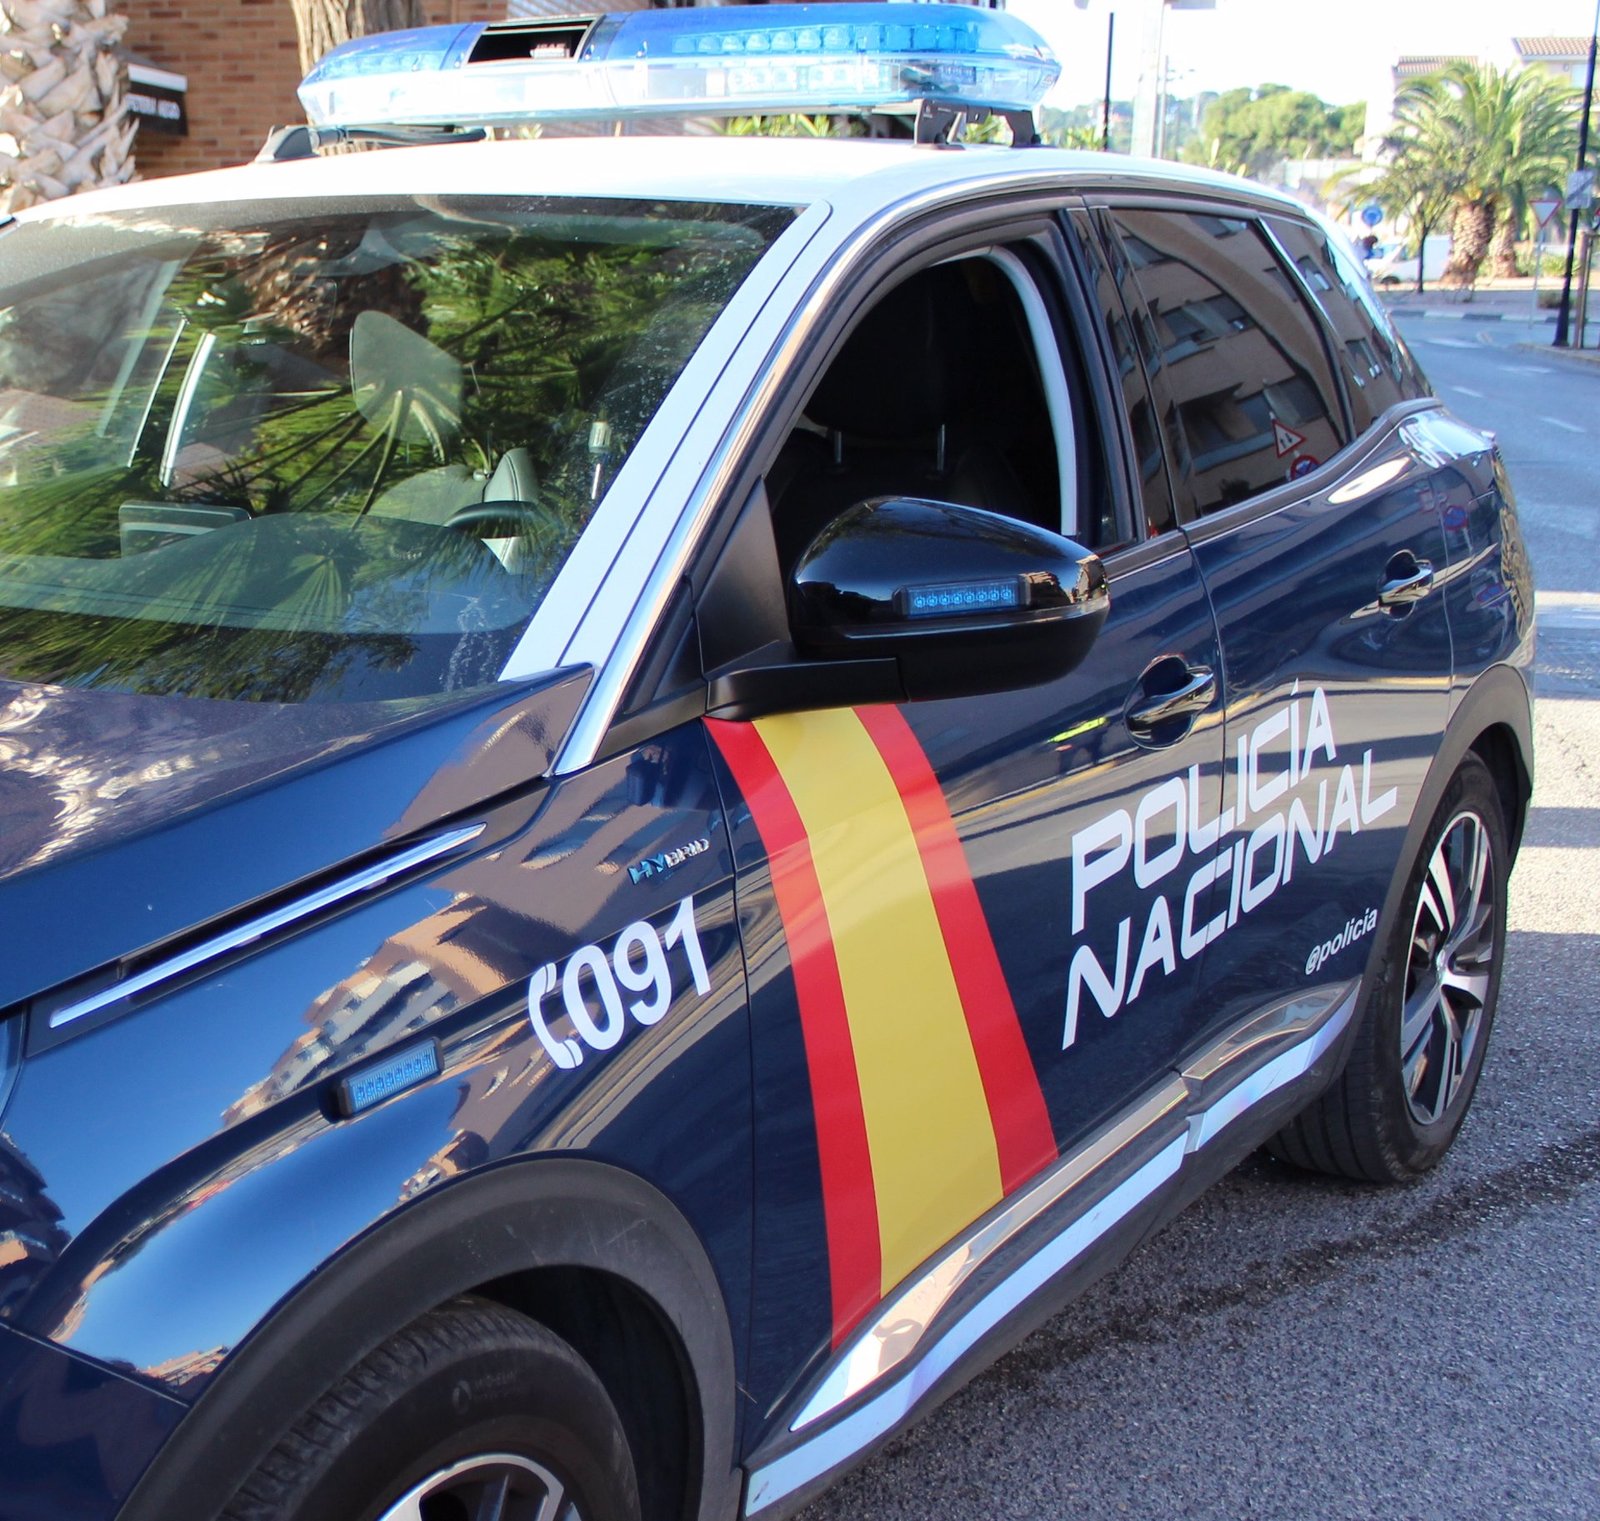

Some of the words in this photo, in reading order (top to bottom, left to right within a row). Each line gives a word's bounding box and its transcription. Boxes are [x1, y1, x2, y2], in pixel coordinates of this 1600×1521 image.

[627, 838, 710, 885] HYBRID
[1062, 749, 1398, 1050] NACIONAL
[1072, 678, 1336, 936] POLICÍA
[562, 895, 712, 1050] 091
